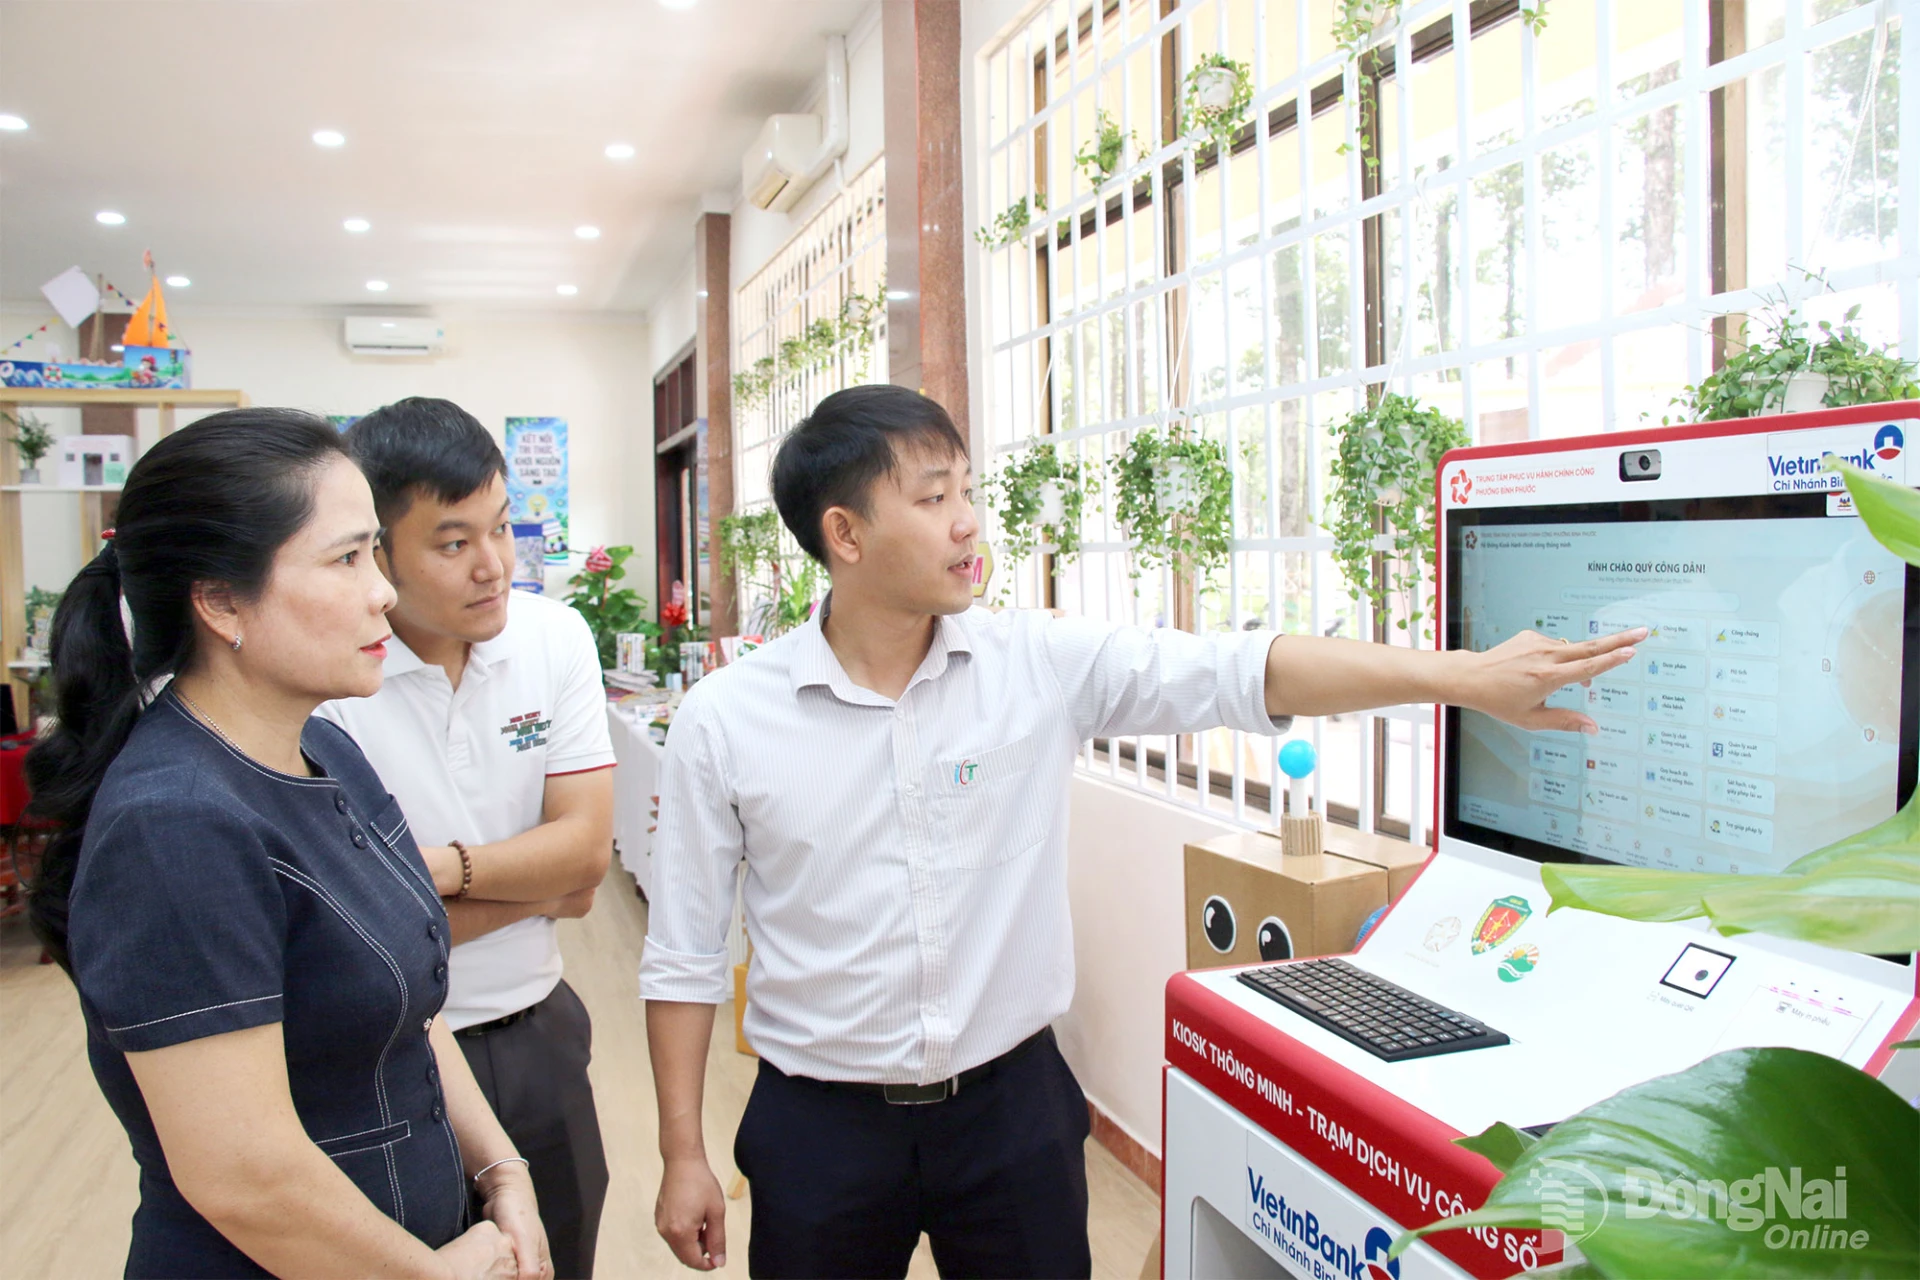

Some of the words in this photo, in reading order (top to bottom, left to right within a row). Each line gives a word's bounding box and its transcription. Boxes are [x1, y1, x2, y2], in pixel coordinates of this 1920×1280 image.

[1496, 473, 1508, 481] TÂM
[1536, 470, 1553, 479] HÀNH
[1554, 469, 1574, 478] CHÍNH
[1575, 467, 1595, 476] CÔNG
[1774, 480, 1790, 491] Chi
[1793, 478, 1827, 490] Nhánh
[1588, 560, 1608, 572] KÍNH
[1610, 561, 1632, 572] CHÀO
[1635, 560, 1652, 574] QUÝ
[1655, 561, 1680, 573] CÔNG
[1682, 562, 1706, 574] DÂN!
[1172, 1018, 1208, 1060] KIOSK
[1209, 1042, 1255, 1090] THÔNG
[1257, 1073, 1292, 1116] MINH
[1307, 1106, 1353, 1156] TRẠM
[1357, 1138, 1400, 1187] DỊCH
[1404, 1167, 1430, 1212] VỤ
[1504, 1232, 1538, 1272] SỐ
[1248, 1166, 1366, 1280] VietinBank
[1253, 1212, 1270, 1239] Chi
[1273, 1228, 1310, 1272] Nhánh
